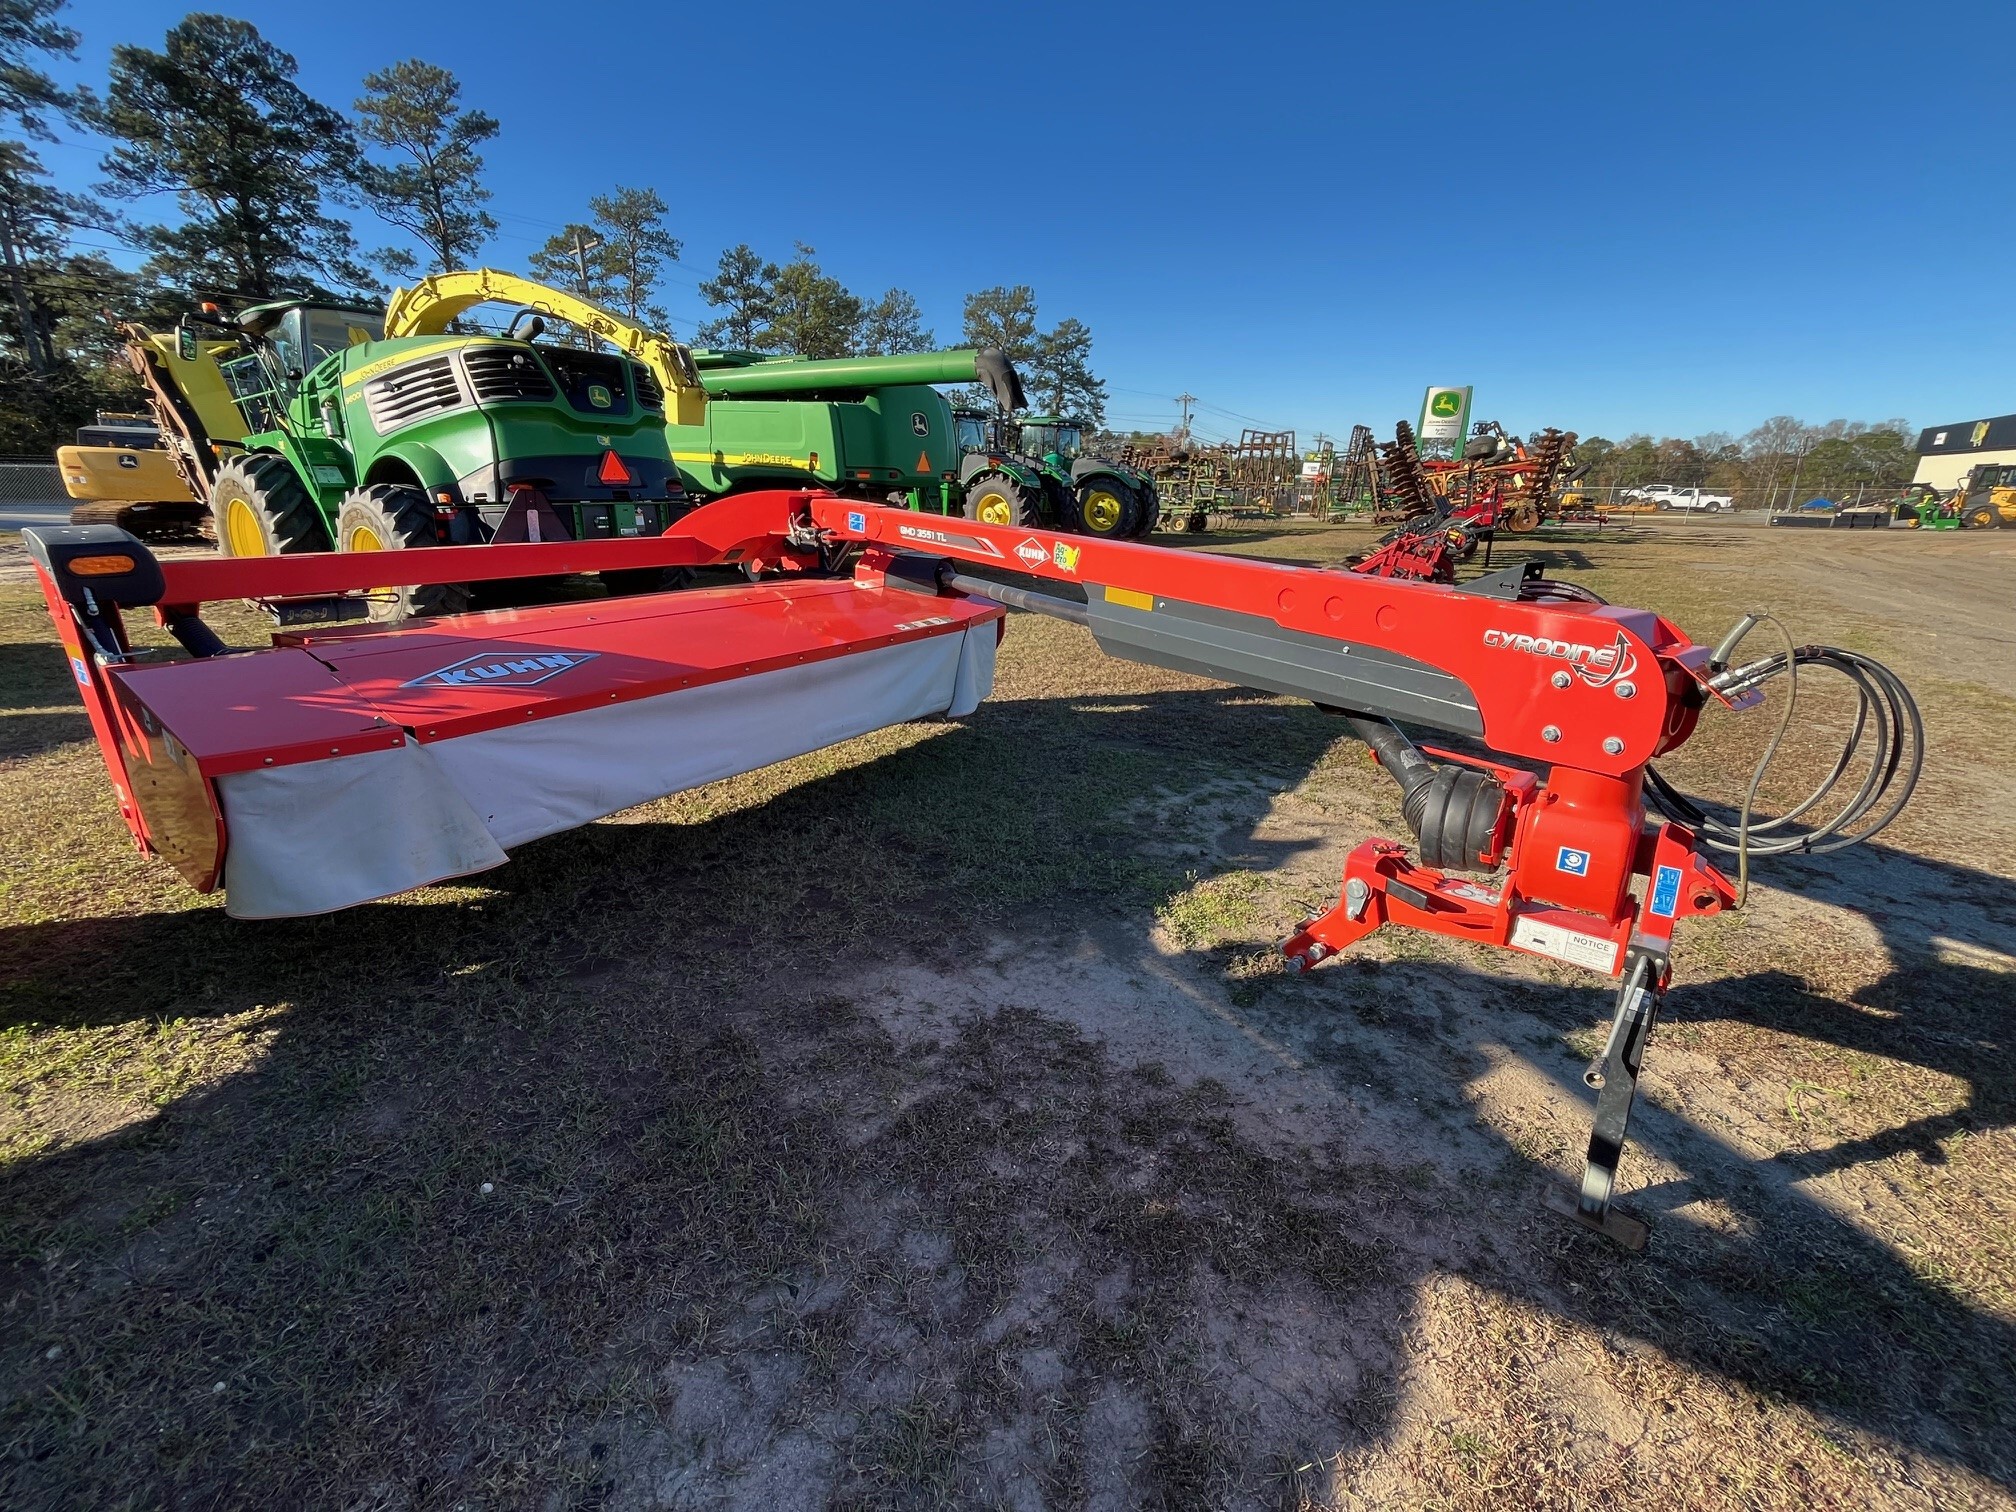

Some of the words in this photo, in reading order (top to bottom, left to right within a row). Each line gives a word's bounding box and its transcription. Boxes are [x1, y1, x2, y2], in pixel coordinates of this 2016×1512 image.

[374, 358, 396, 372] DEERE
[742, 452, 763, 463] JOHN
[763, 453, 792, 465] DEERE
[900, 526, 915, 537] GMD
[917, 529, 935, 540] 3551
[936, 532, 947, 543] TL
[1019, 546, 1045, 561] KUHN
[1055, 553, 1067, 563] Pro
[1483, 629, 1617, 667] GYRODINE
[437, 654, 575, 684] KUHN
[1573, 936, 1610, 952] NOTICE
